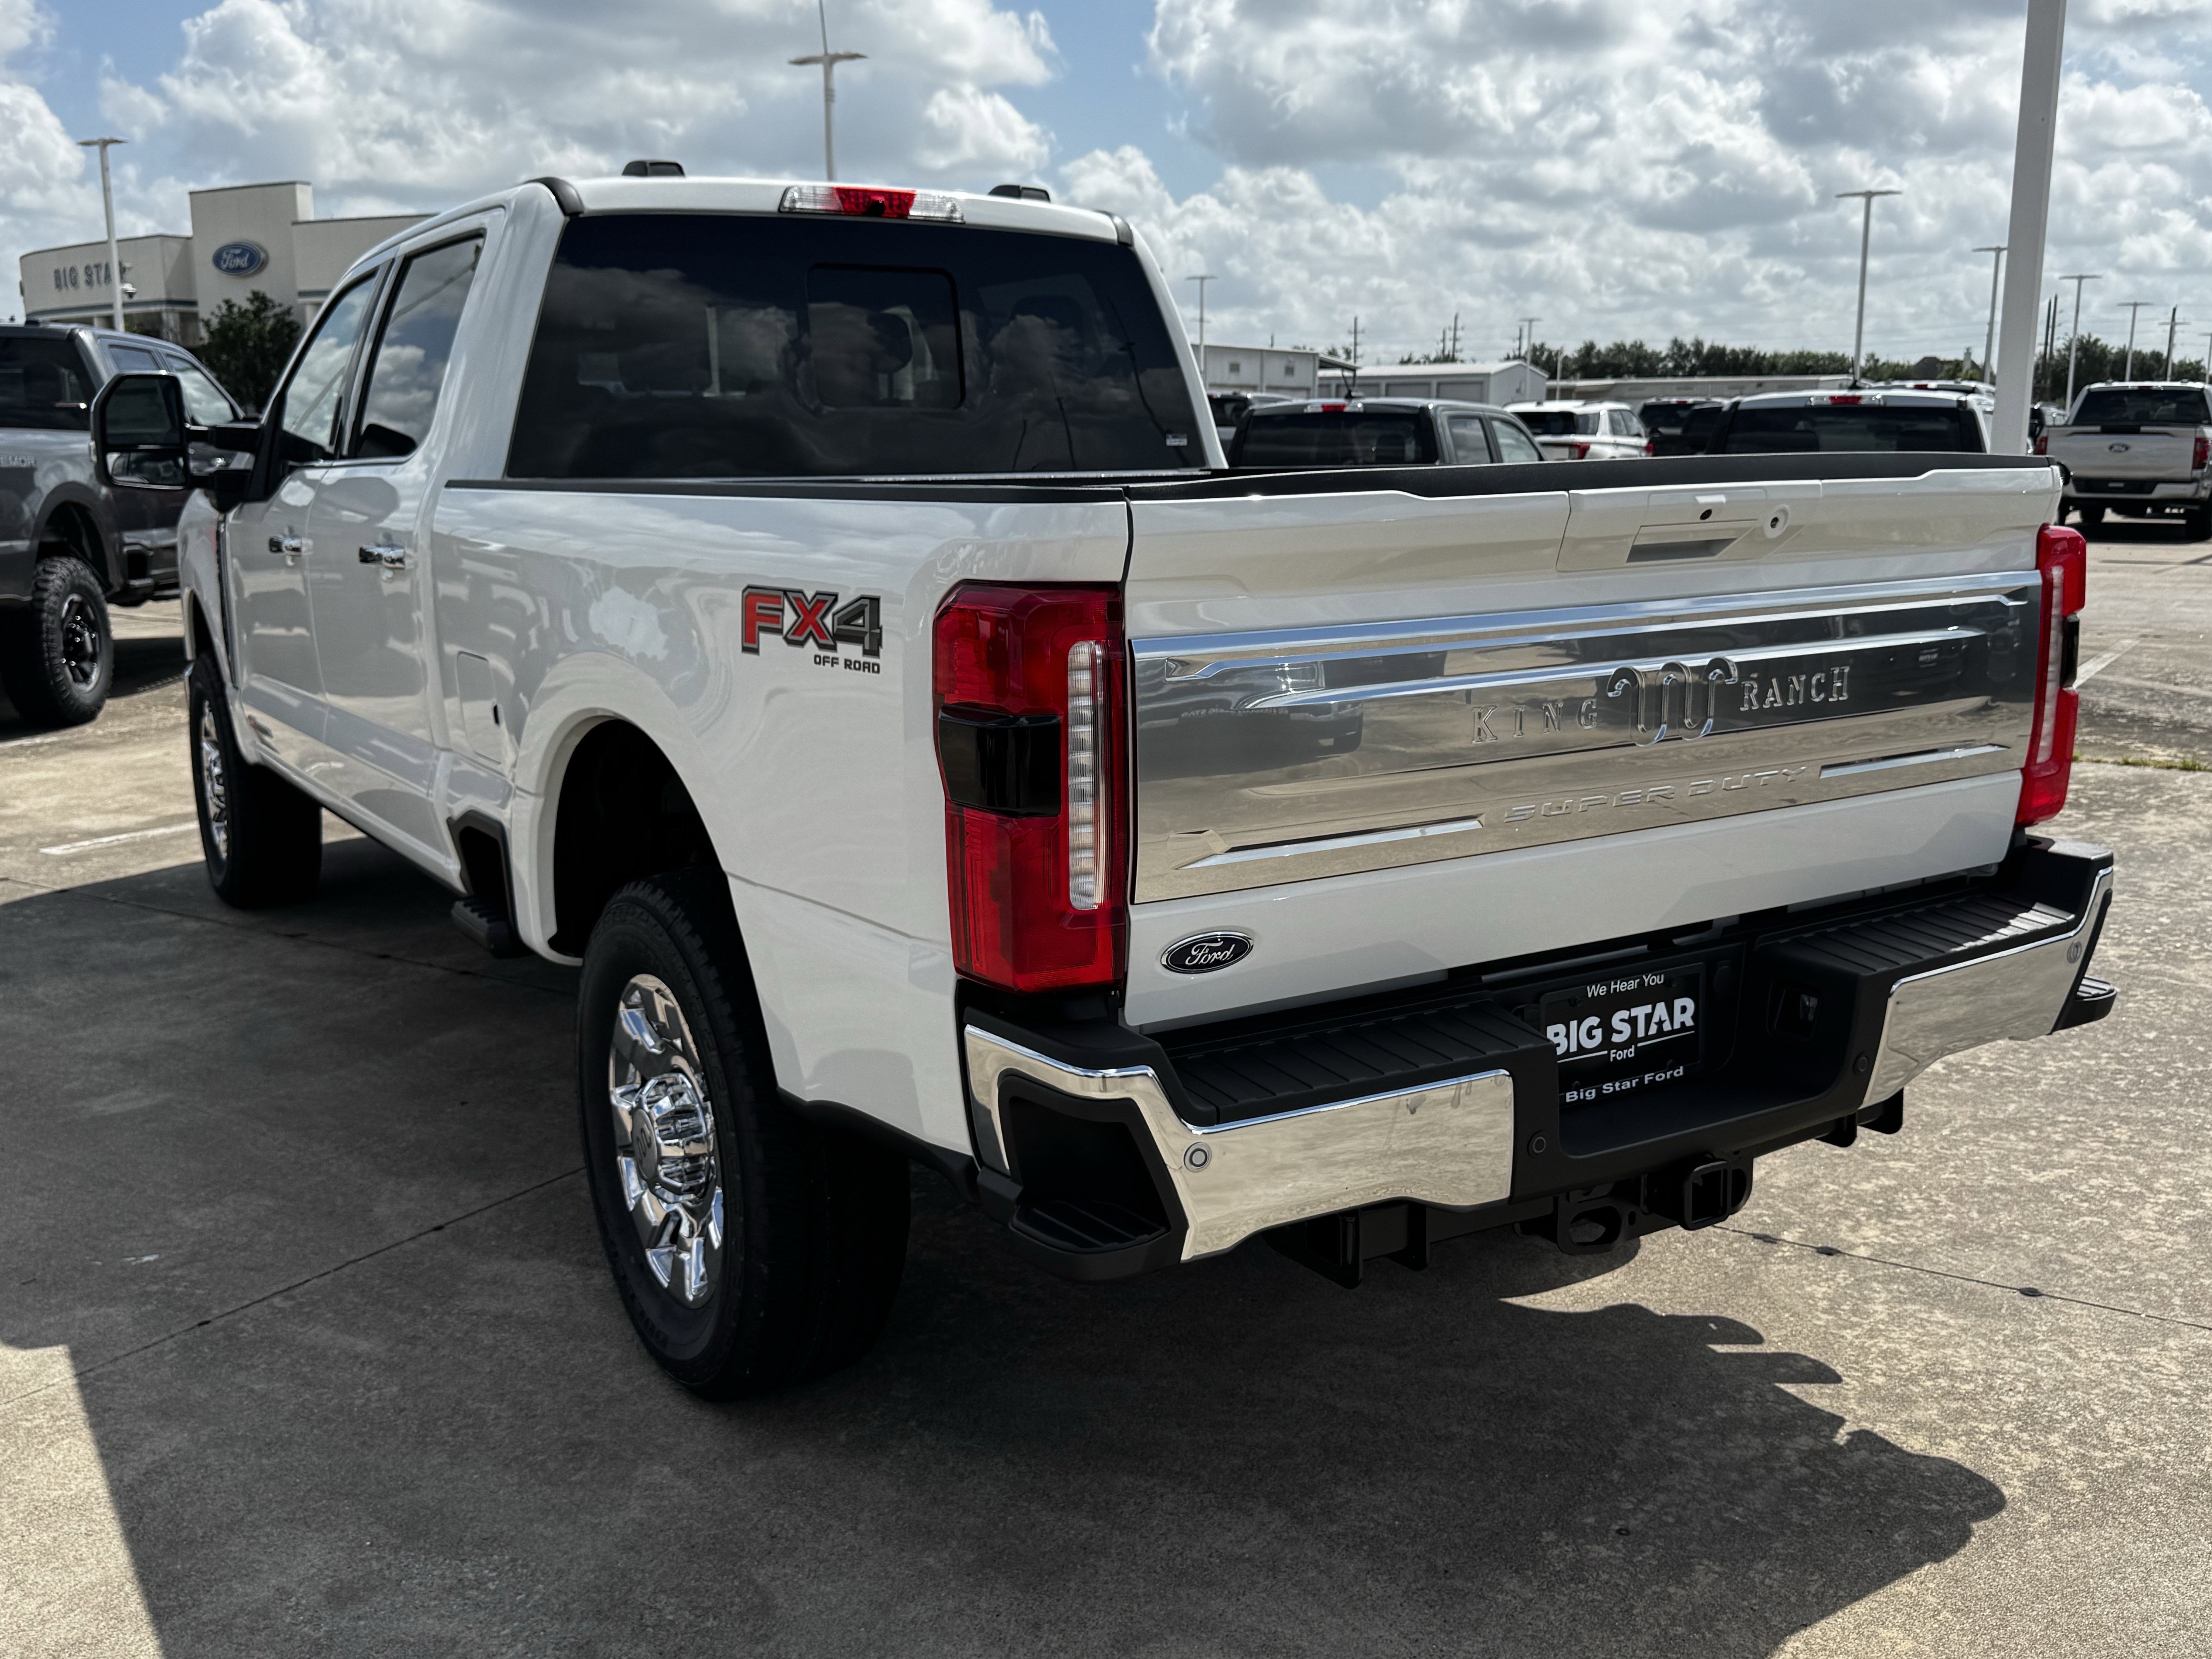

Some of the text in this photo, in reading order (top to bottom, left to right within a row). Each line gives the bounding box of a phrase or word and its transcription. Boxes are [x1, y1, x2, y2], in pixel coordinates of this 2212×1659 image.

[220, 248, 250, 269] Ford
[54, 266, 79, 291] BIG
[742, 584, 883, 658] FX4
[814, 654, 880, 674] OFF ROAD
[1471, 665, 1849, 744] KING RANCH
[1504, 766, 1807, 823] SUPER DUTY
[1185, 941, 1235, 965] Ford
[1587, 973, 1664, 998] We Hear You
[1546, 997, 1695, 1056] BIG STAR
[1610, 1045, 1635, 1061] Ford
[1566, 1066, 1684, 1103] Big Star Ford
